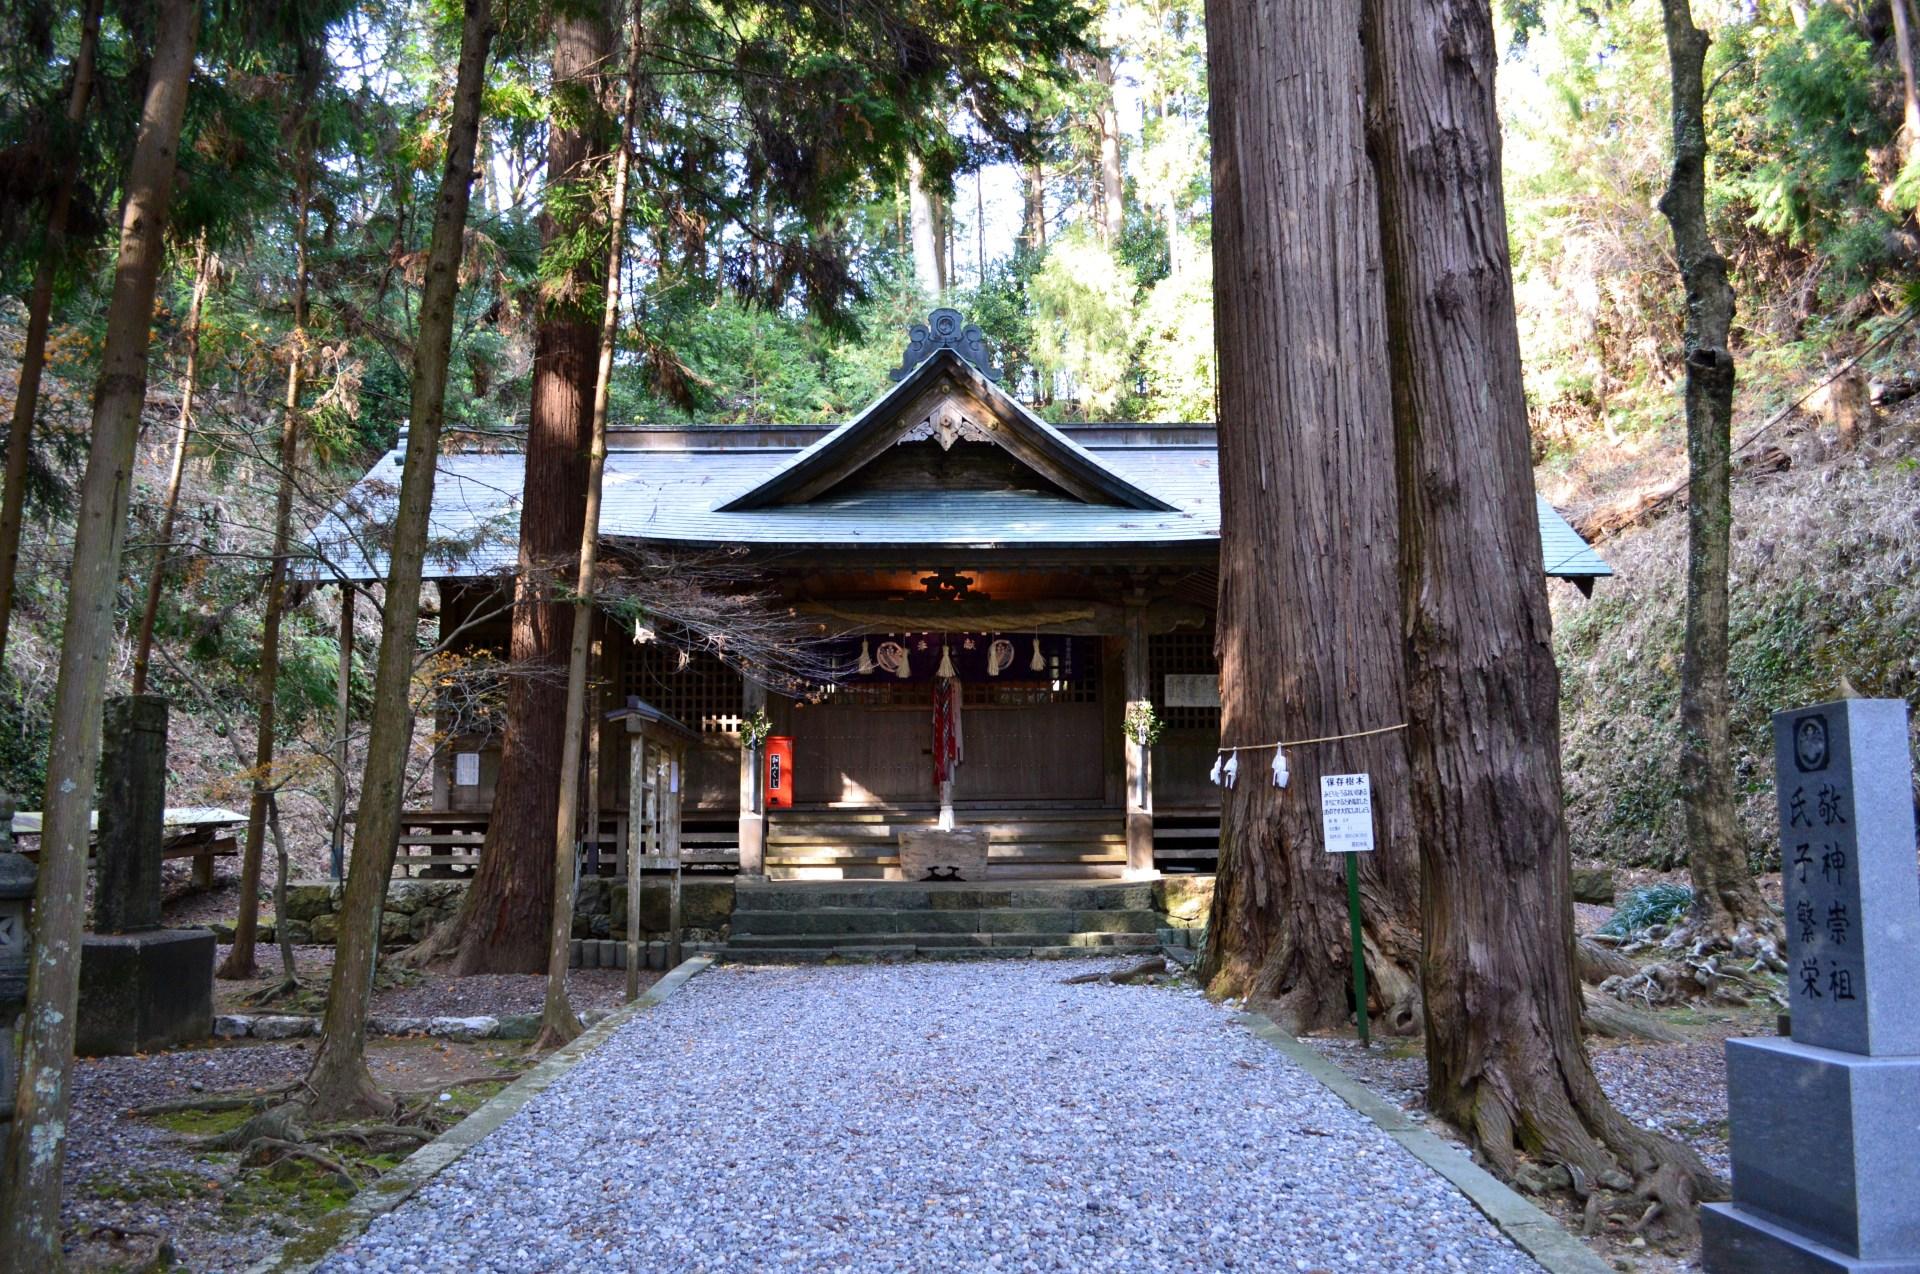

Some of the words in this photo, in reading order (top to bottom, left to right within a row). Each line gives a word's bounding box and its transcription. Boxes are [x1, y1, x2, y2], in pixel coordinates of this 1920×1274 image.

[771, 755, 780, 788] おみくじ
[1326, 776, 1365, 787] 保存樹木
[1789, 786, 1822, 1000] 氏子繁栄
[1818, 783, 1856, 1001] 敬神崇祖
